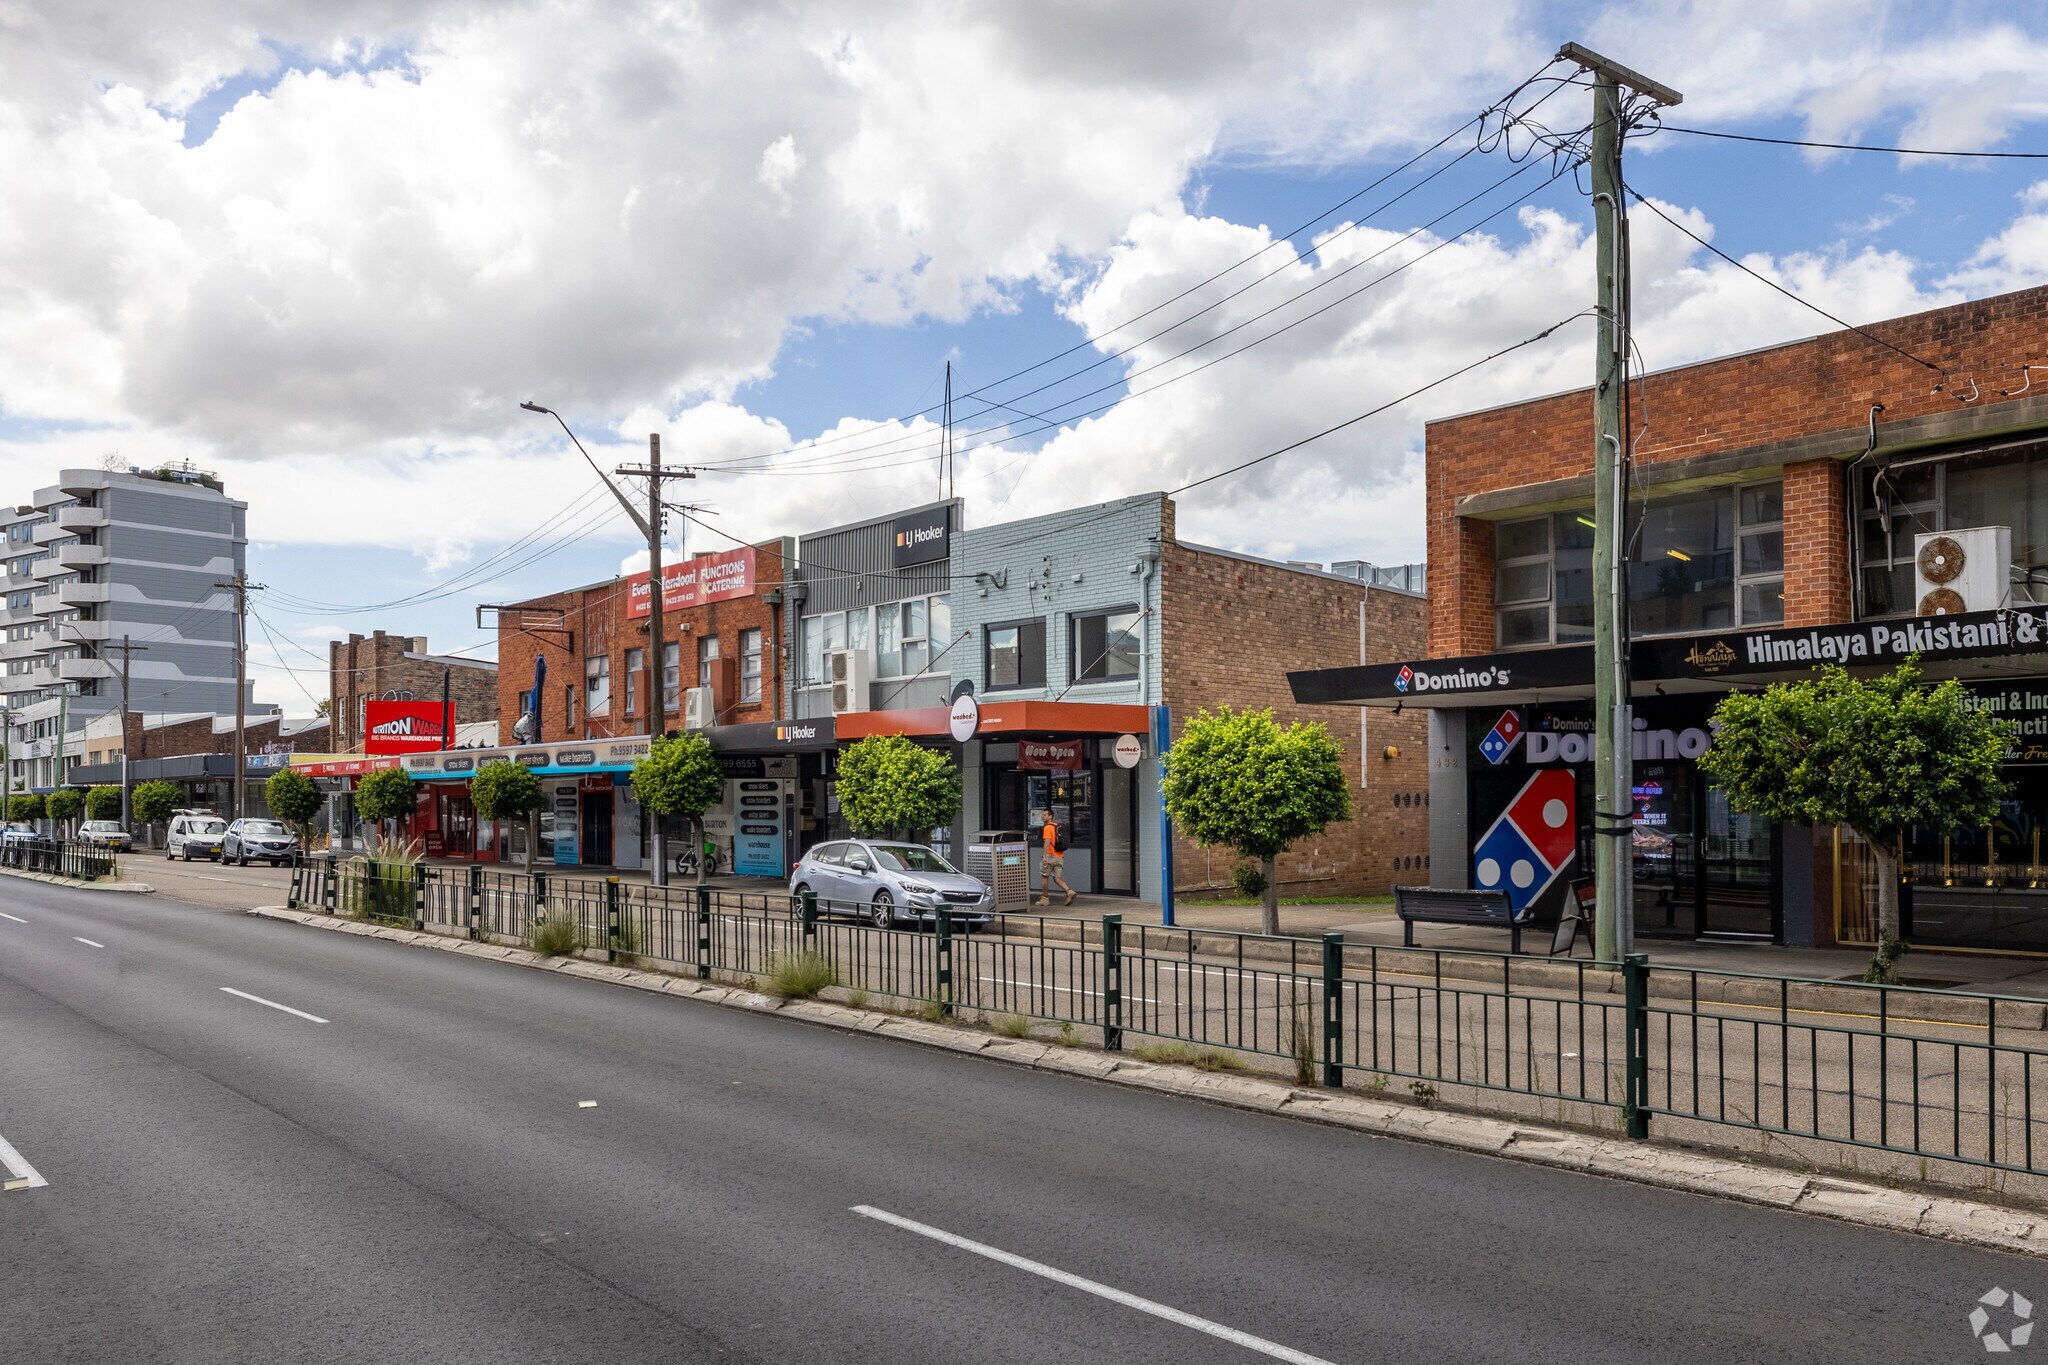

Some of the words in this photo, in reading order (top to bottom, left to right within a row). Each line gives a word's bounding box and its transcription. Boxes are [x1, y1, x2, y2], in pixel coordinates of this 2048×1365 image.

[914, 525, 944, 543] Hooker
[700, 560, 745, 581] FUNCTIONS
[1746, 631, 1868, 663] Himalaya
[1871, 614, 2008, 655] Pakistani
[2016, 612, 2040, 643] &
[1414, 666, 1510, 691] Domino's
[1959, 692, 2006, 712] istani
[2009, 692, 2022, 710] &
[372, 716, 411, 735] NUTRITION
[792, 725, 816, 739] Hooker
[634, 744, 648, 755] 3422
[1025, 745, 1047, 757] Now
[1050, 745, 1074, 760] Open
[736, 759, 757, 767] 6555
[704, 820, 727, 829] BURTON
[748, 841, 771, 849] warehouse
